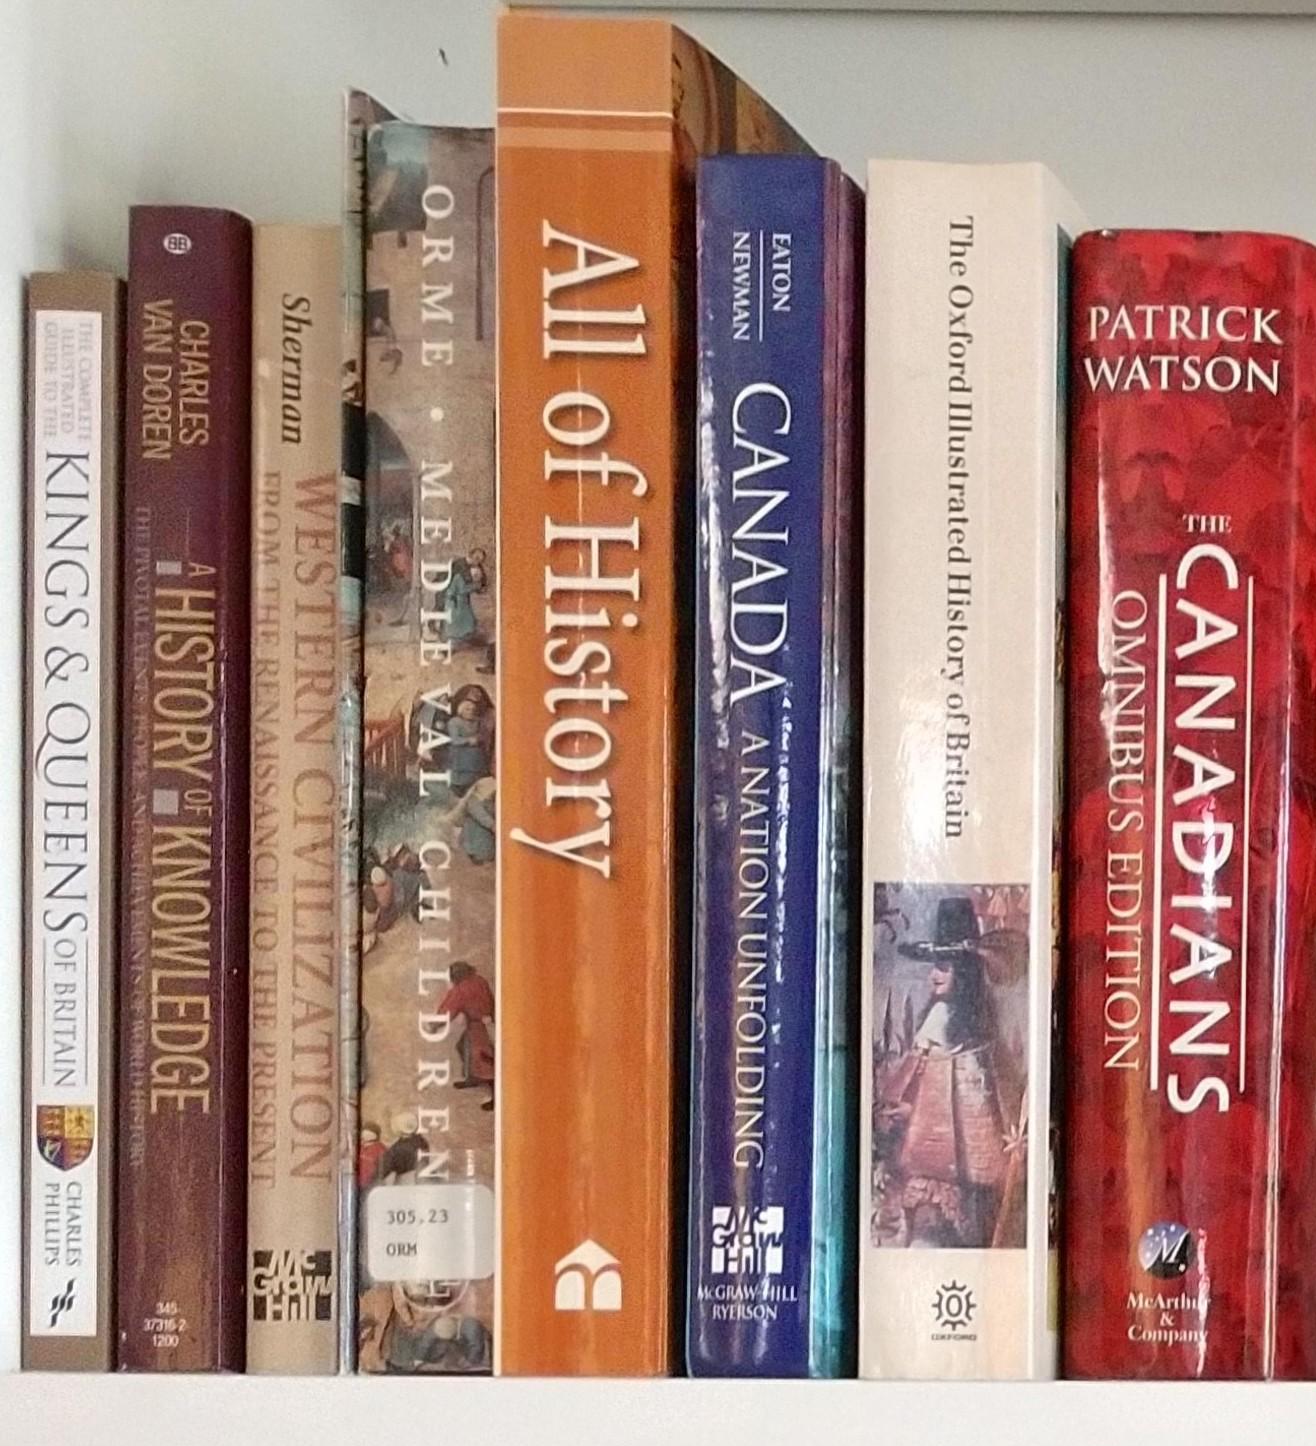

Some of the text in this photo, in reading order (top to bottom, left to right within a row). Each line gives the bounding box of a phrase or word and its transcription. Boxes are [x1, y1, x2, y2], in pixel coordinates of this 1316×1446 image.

[733, 231, 750, 342] NEWMAN
[771, 232, 792, 312] EATON
[1089, 304, 1283, 345] PATRICK
[143, 299, 173, 460] VAN DOREN
[179, 320, 210, 446] CHARLES
[282, 294, 312, 444] Sherman
[1083, 355, 1280, 396] WATSON
[510, 220, 649, 880] All of History
[940, 216, 974, 839] The Oxford Illustrated History of Britain
[1182, 514, 1232, 534] THE
[35, 452, 91, 933] KINGS & QUEENS
[416, 185, 456, 1180] ORME MEDIEVAL CHILDREN
[151, 562, 217, 1114] A HISTORY OF KNOWLEDGE
[291, 472, 337, 1182] WESTERN CIVILIZATION
[730, 382, 792, 1171] CANADA A NATION UNFOLDING
[1104, 590, 1147, 1072] OMNIBUS EDITION
[1167, 543, 1239, 1114] CANADIANS
[51, 939, 77, 1088] OF BRITAIN
[45, 1183, 60, 1266] PHILLIPS
[66, 1182, 82, 1268] CHARLES
[385, 1243, 417, 1257] ORM
[711, 1303, 778, 1321] RYERSON
